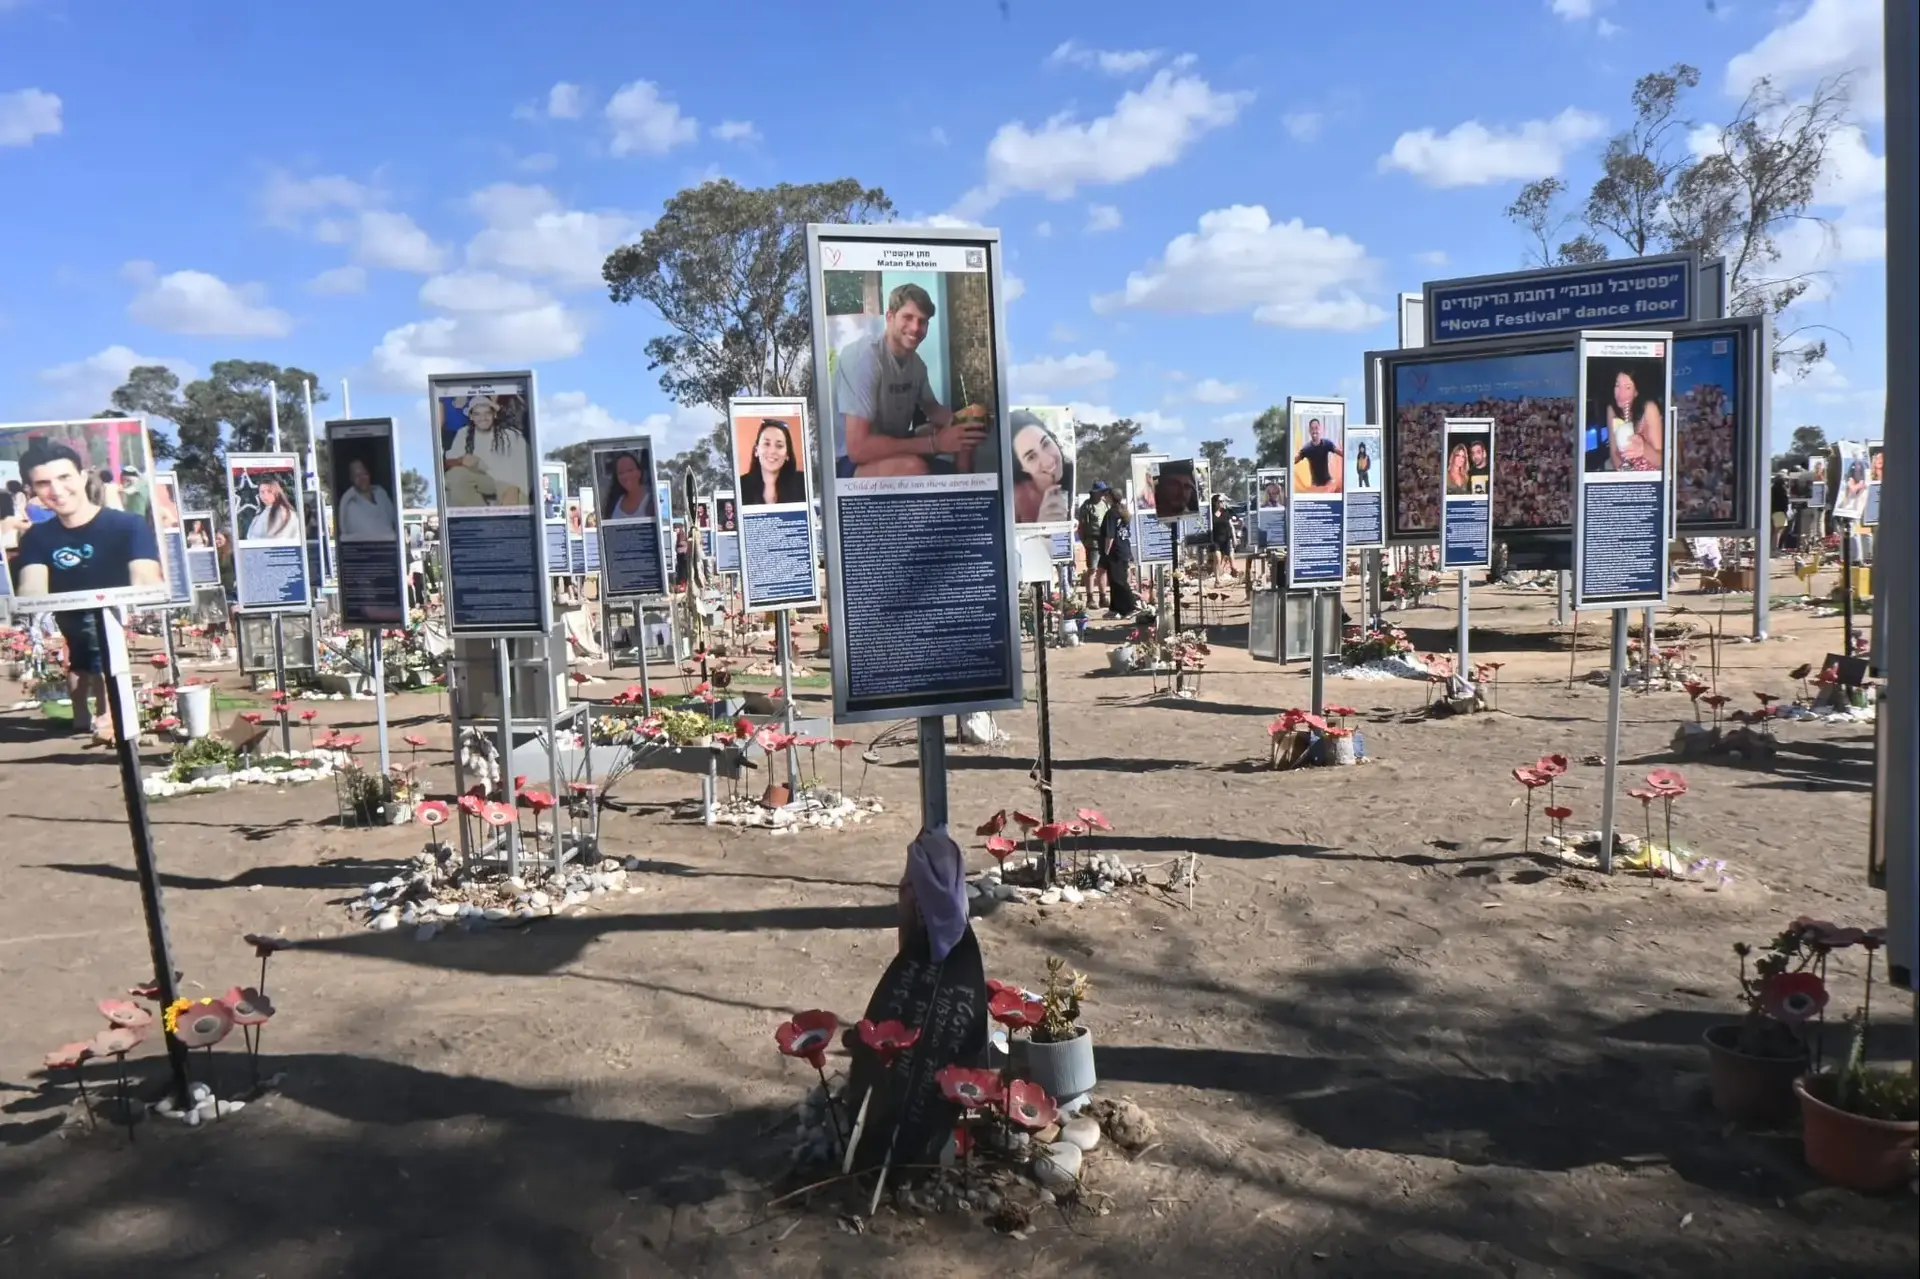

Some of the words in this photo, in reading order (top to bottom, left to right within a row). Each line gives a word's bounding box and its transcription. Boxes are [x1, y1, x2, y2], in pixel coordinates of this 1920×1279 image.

[1441, 292, 1509, 311] הריקודים
[1513, 288, 1555, 304] רחבת
[1574, 304, 1631, 319] dance
[1635, 299, 1678, 313] floor
[897, 480, 909, 489] the
